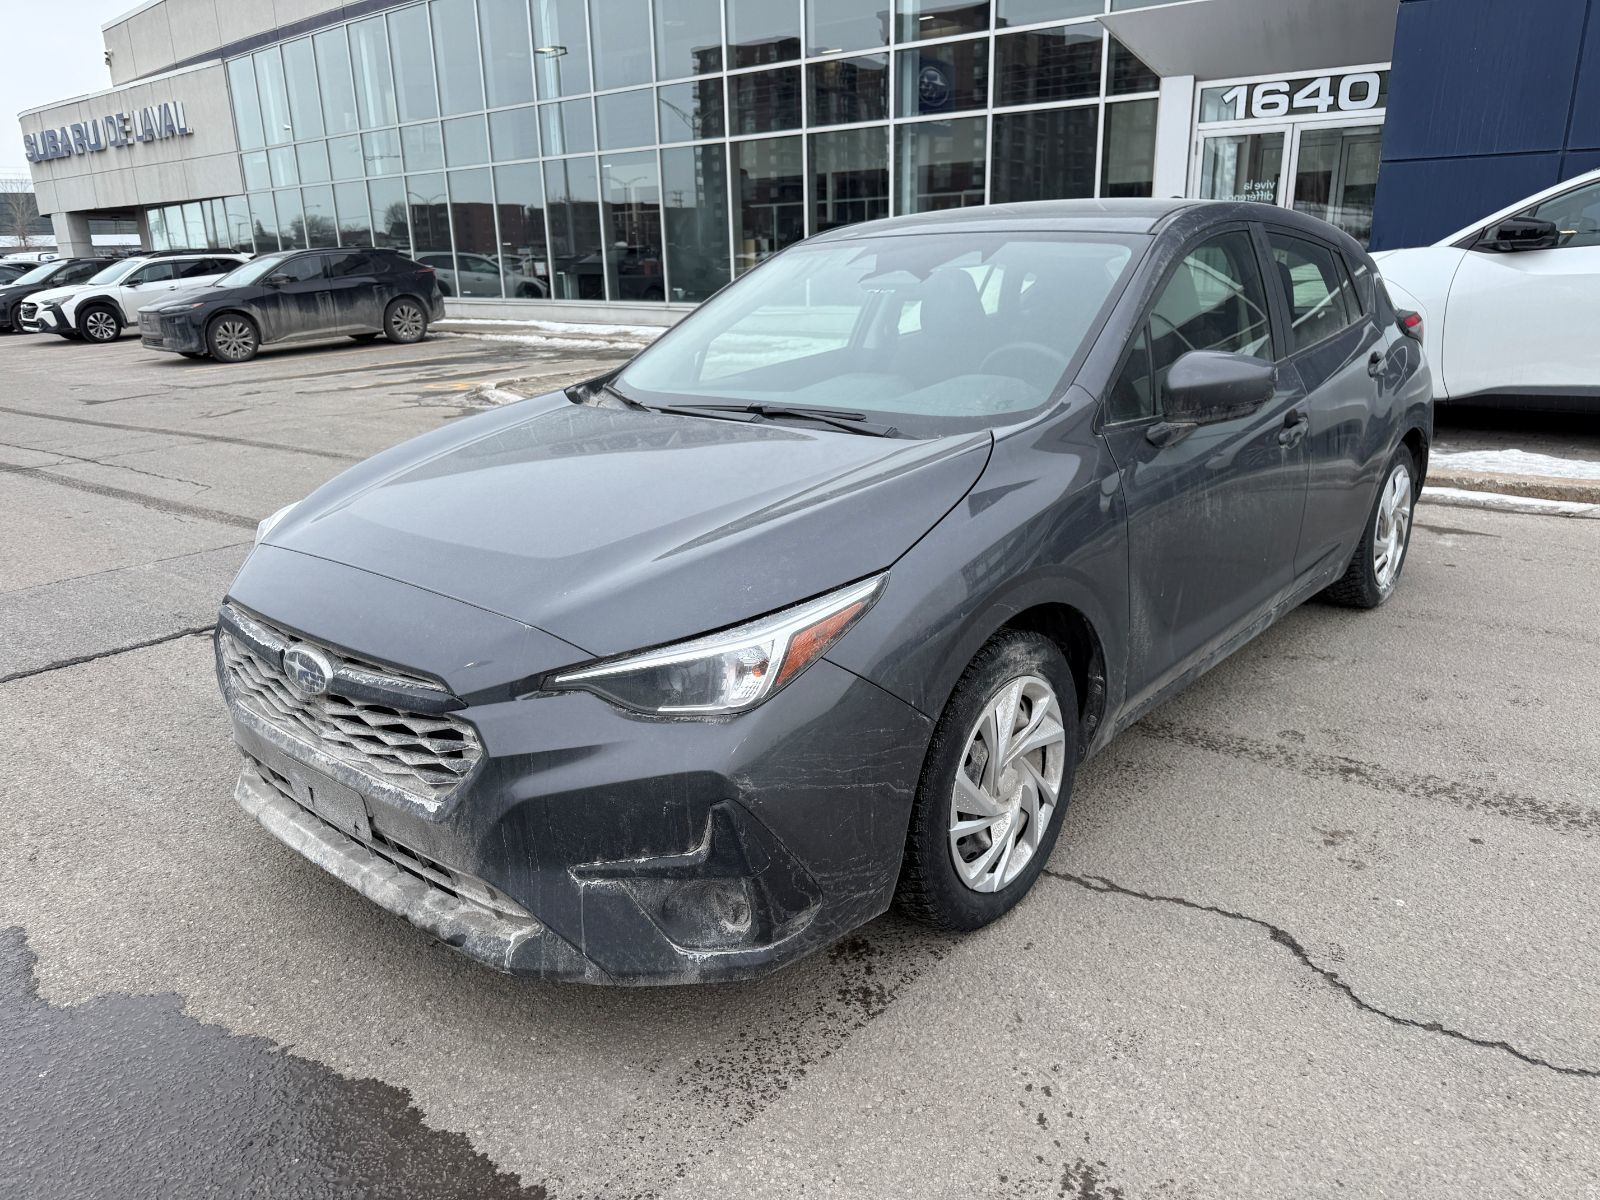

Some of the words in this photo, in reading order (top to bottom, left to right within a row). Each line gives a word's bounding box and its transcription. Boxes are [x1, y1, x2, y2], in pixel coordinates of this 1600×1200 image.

[1221, 73, 1381, 120] 1640
[24, 120, 107, 163] SUBARU
[104, 113, 134, 148] DE
[131, 101, 194, 143] LAVAL
